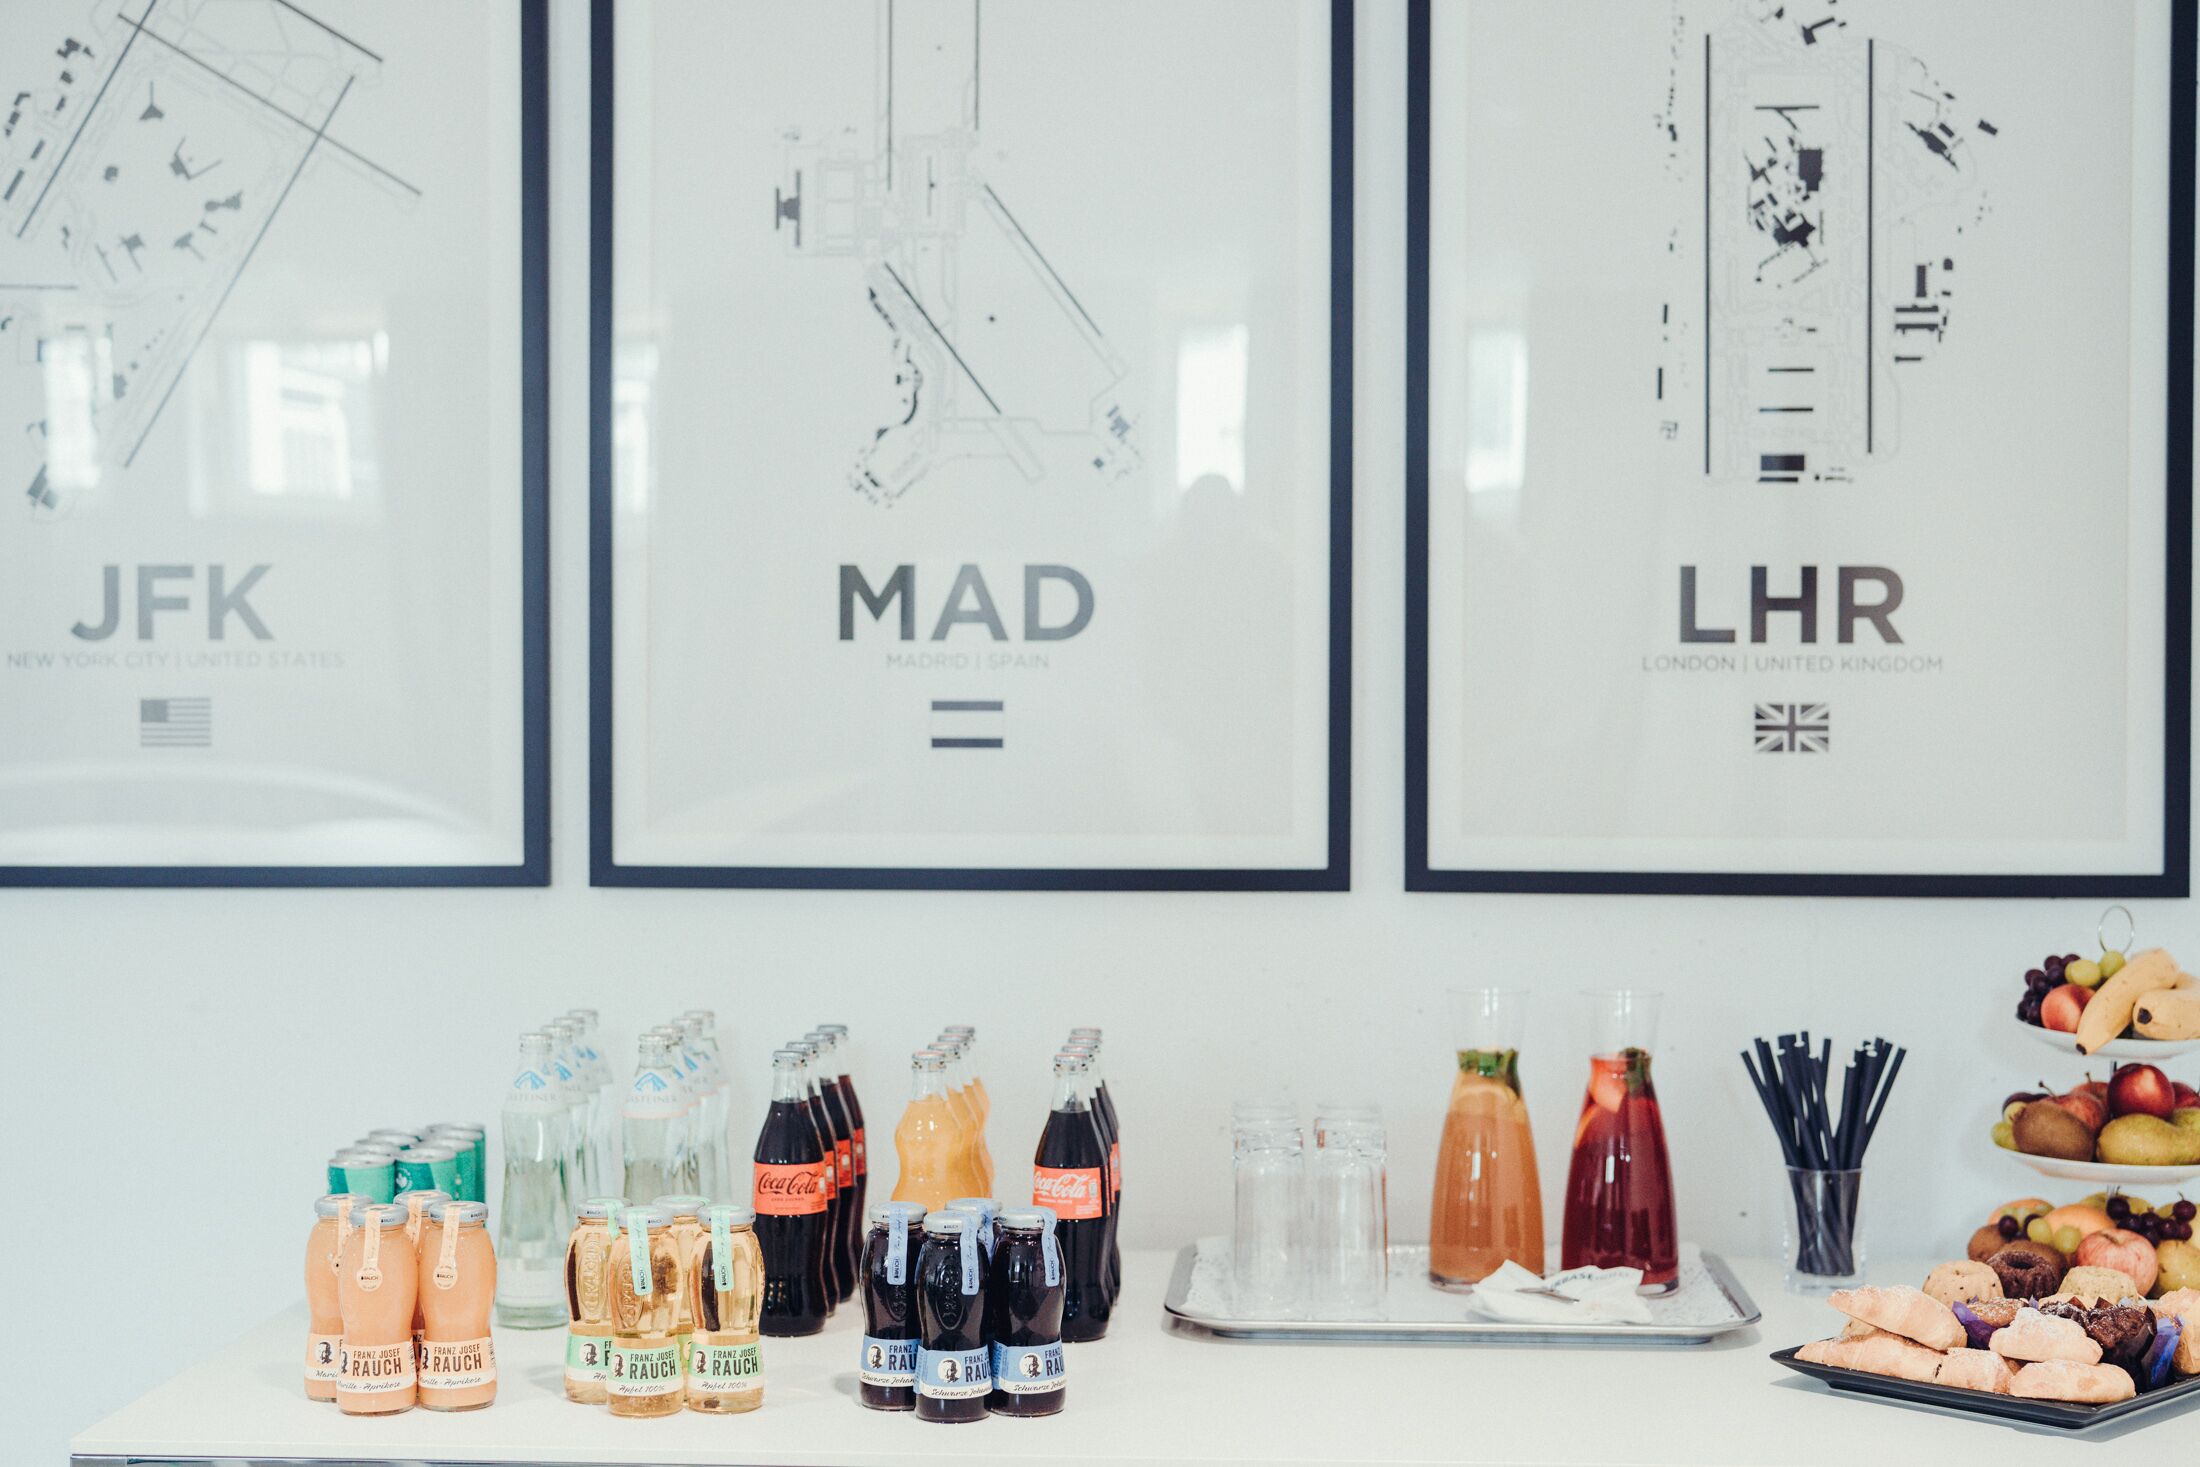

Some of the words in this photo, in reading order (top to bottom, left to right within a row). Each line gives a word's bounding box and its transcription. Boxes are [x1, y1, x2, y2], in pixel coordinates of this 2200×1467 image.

[71, 565, 274, 640] JFK
[839, 564, 1095, 641] MAD
[1680, 565, 1904, 644] LHR
[7, 652, 54, 668] NEW
[63, 651, 118, 668] YORK
[125, 650, 168, 667] CITY
[188, 651, 262, 668] UNITED
[267, 651, 346, 669] STATES
[885, 653, 970, 669] MADRID
[989, 653, 1050, 669] SPAIN
[1641, 655, 1736, 673] LONDON
[1755, 655, 1834, 673] UNITED
[1840, 655, 1943, 673] KINGDOM
[353, 1350, 376, 1360] FRANZ
[379, 1347, 401, 1359] JOSEF
[434, 1346, 457, 1356] FRANZ
[459, 1343, 480, 1355] JOSEF
[630, 1353, 654, 1362] FRANZ
[656, 1349, 674, 1361] JOSEF
[713, 1350, 737, 1359] FRANZ
[739, 1346, 757, 1358] JOSEF
[889, 1344, 912, 1354] FRANZ
[352, 1357, 403, 1377] RAUCH
[433, 1352, 482, 1372] RAUCH
[712, 1356, 758, 1376] RAUCH
[888, 1354, 917, 1371] RAU
[964, 1355, 984, 1365] FRANZ
[629, 1359, 677, 1380] RAUCH
[618, 1384, 642, 1394] Apfel
[645, 1384, 665, 1393] 100%
[700, 1381, 725, 1390] Apfel
[727, 1380, 747, 1389] 100%
[931, 1388, 968, 1396] Schwarze
